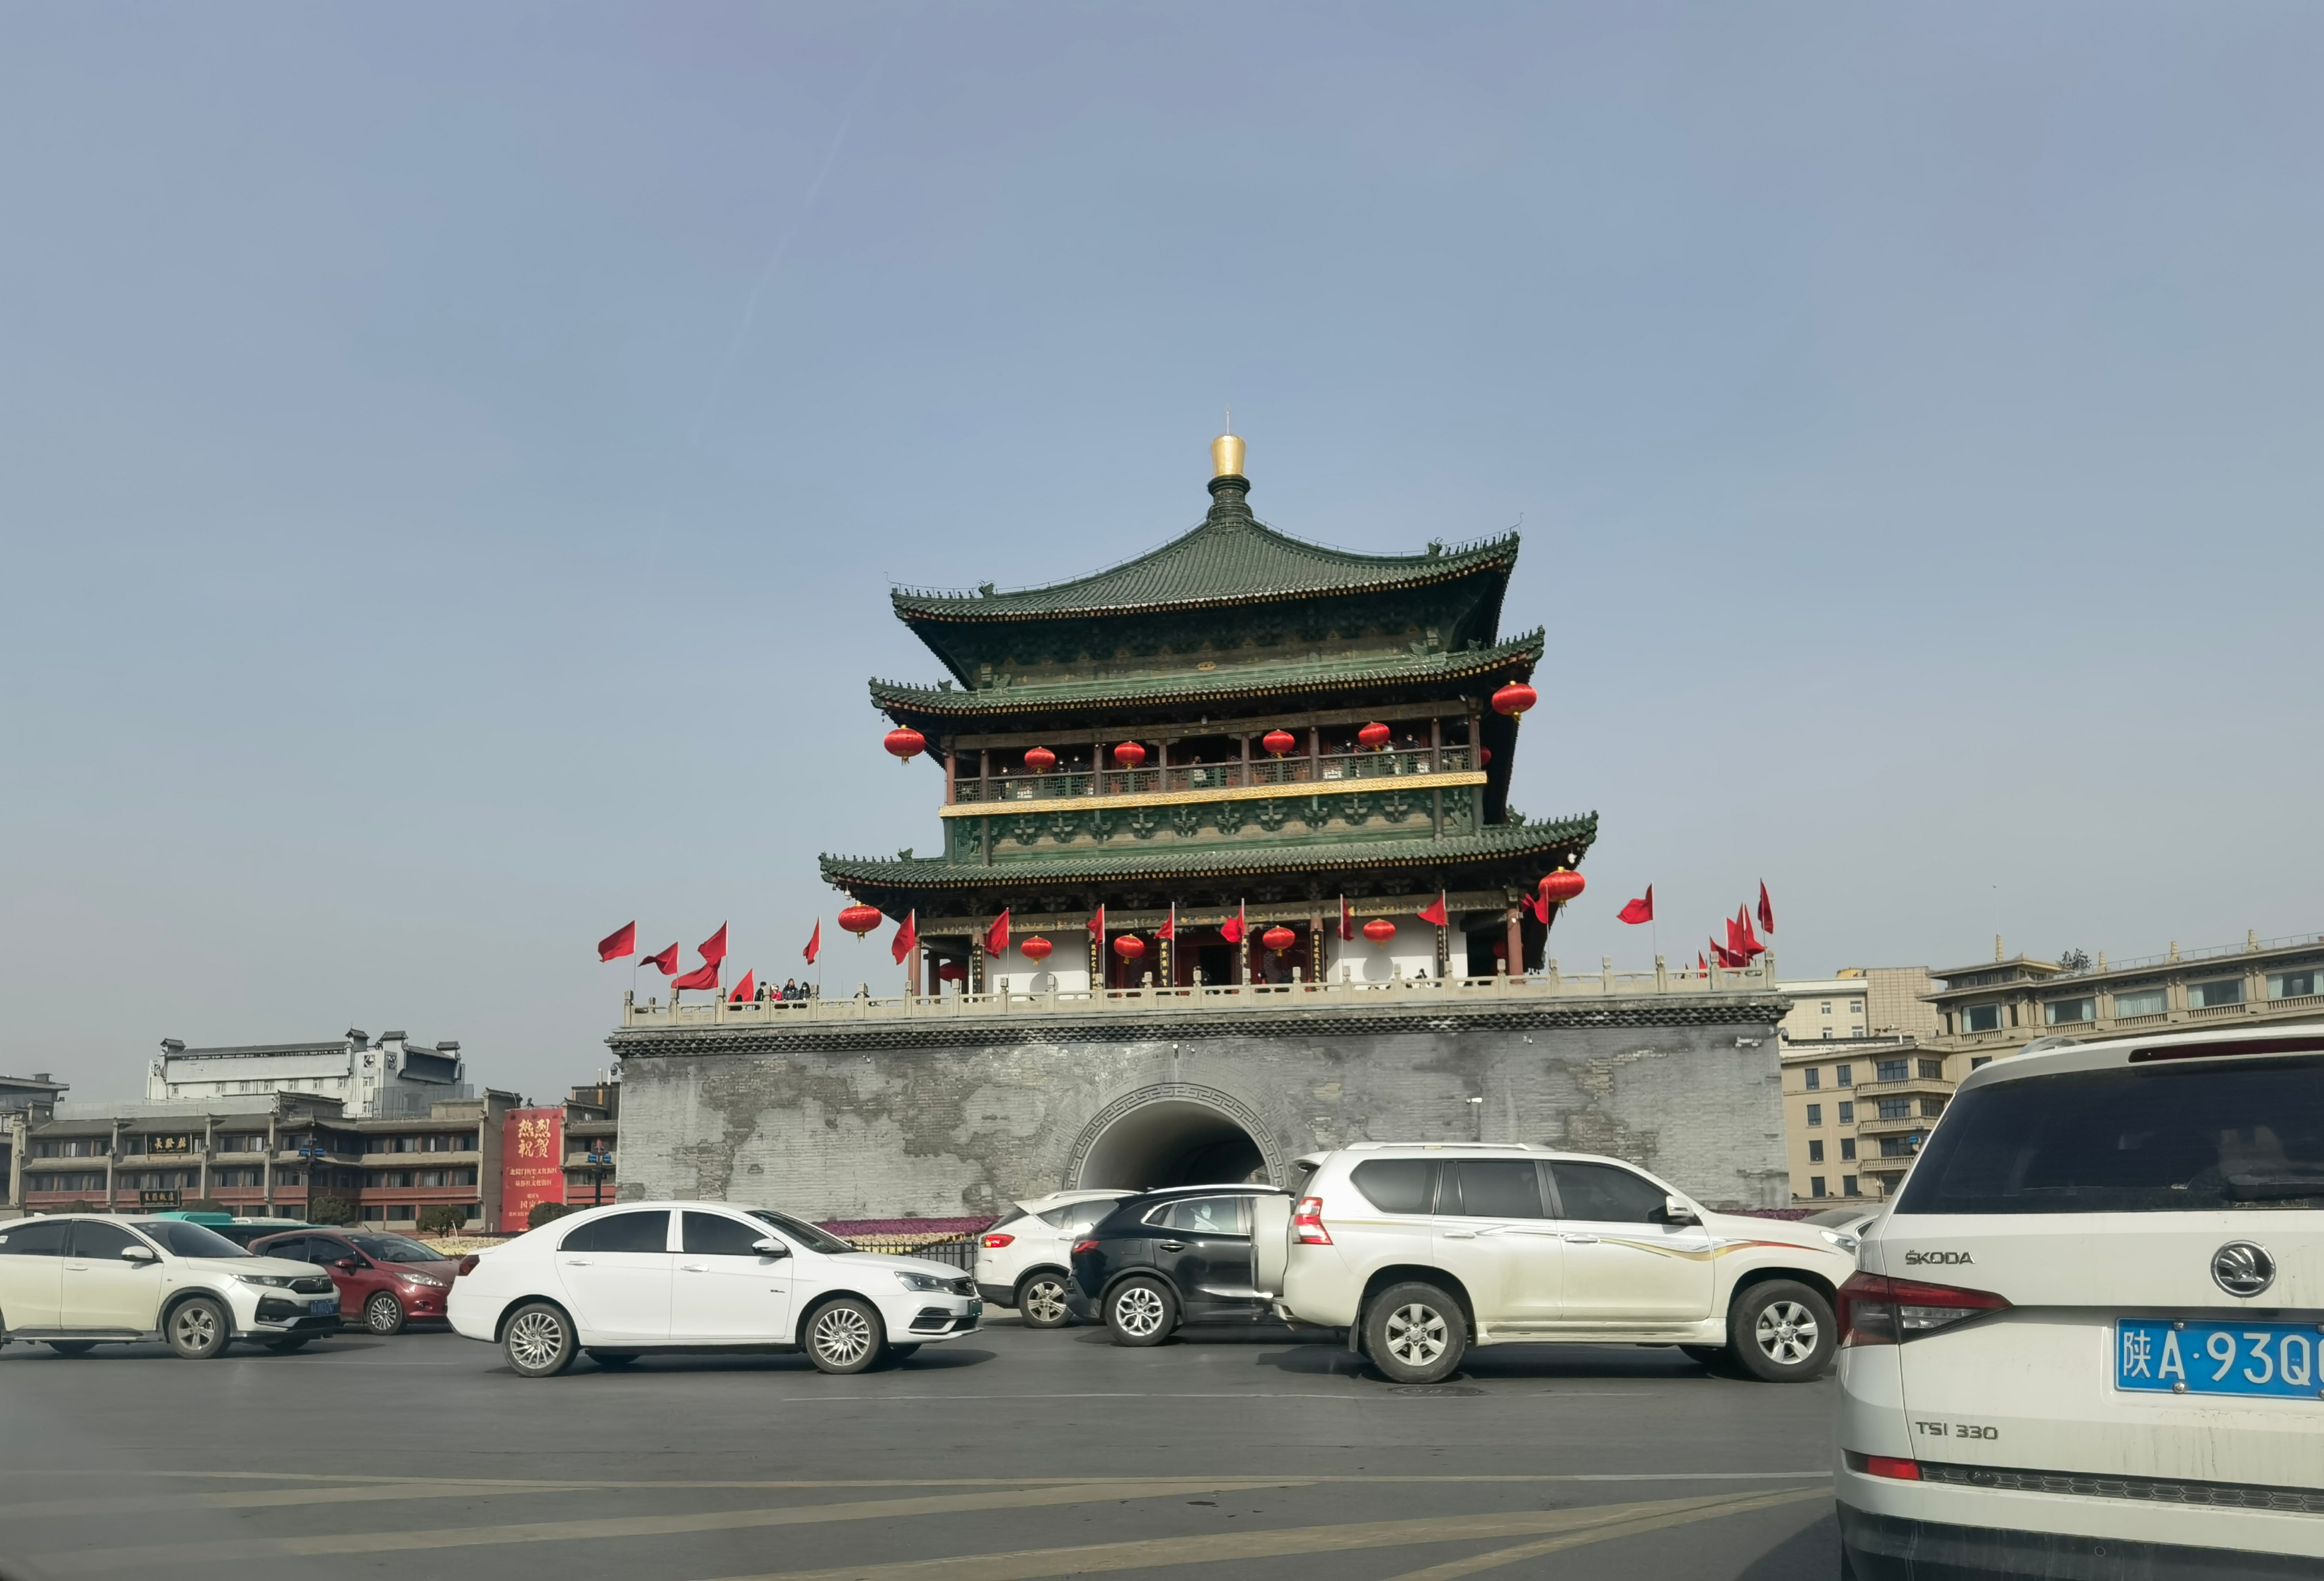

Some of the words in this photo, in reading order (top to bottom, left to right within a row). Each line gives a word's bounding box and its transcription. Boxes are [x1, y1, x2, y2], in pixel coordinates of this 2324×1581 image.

[518, 1119, 551, 1138] 热烈
[1905, 1249, 1976, 1265] ŠKODA
[2123, 1329, 2324, 1386] 陕A·93Q
[1915, 1421, 1949, 1436] TSI
[1956, 1424, 1999, 1439] 330
